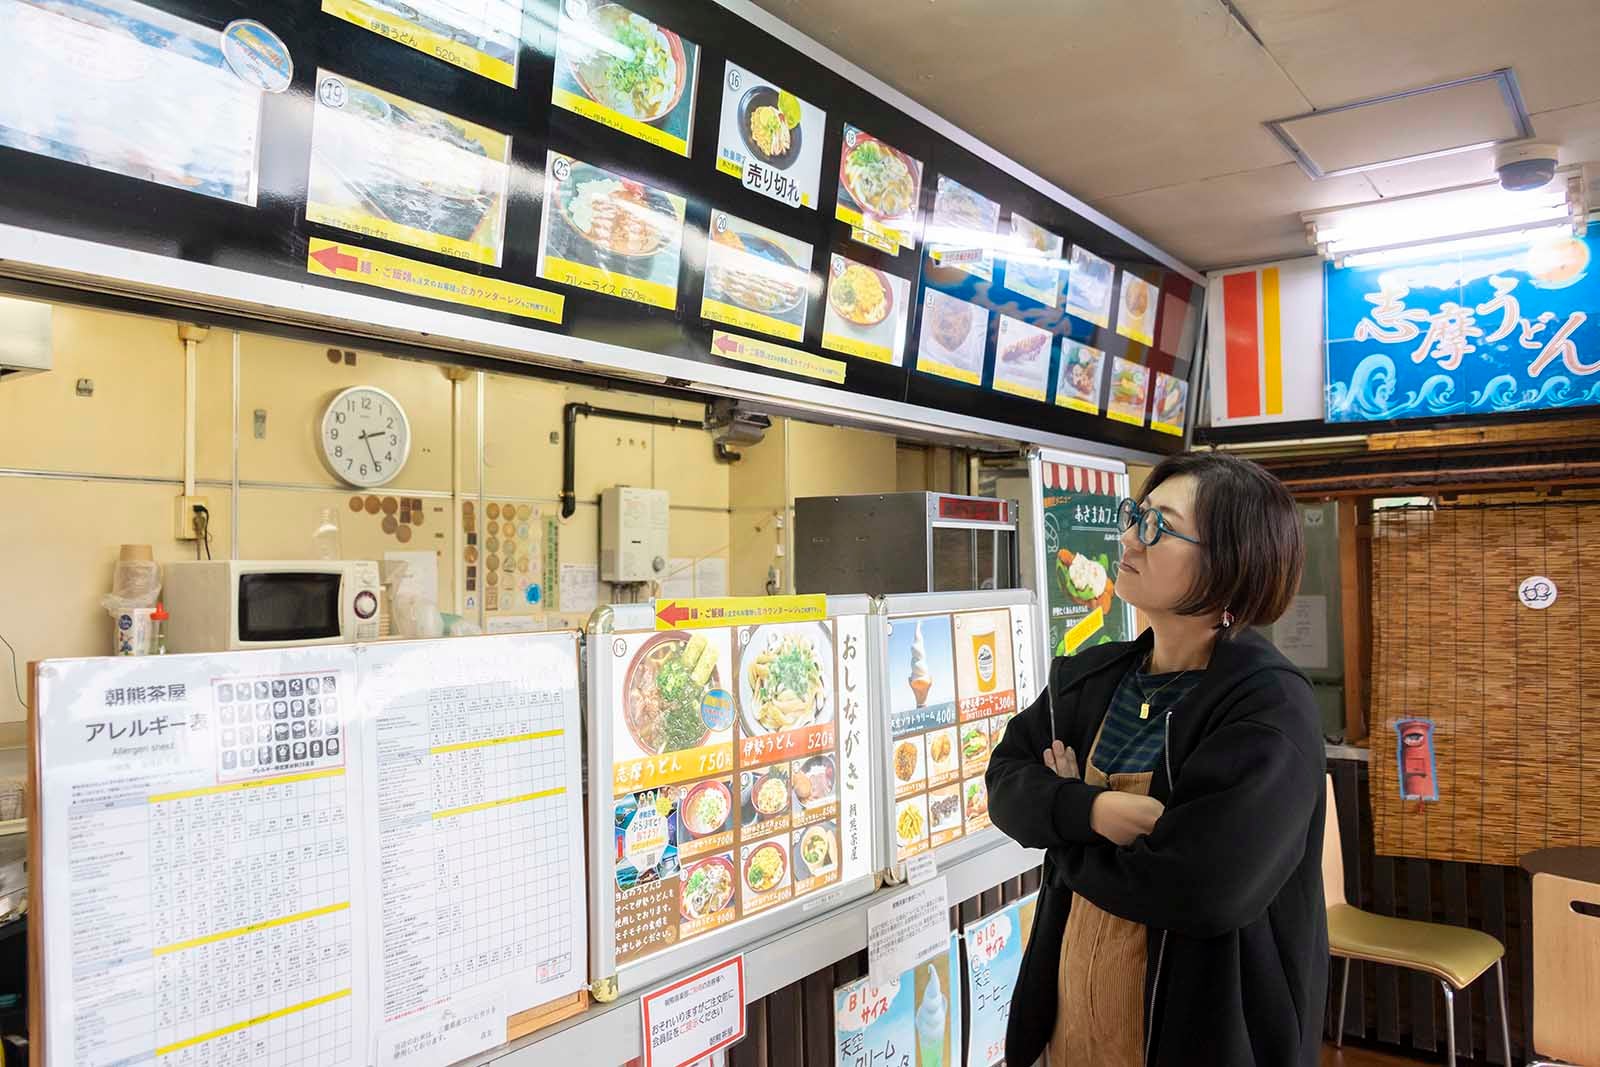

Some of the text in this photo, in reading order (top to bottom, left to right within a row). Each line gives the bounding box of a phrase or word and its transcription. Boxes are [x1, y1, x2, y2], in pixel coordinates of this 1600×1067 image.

[370, 19, 418, 48] 伊勢うどん
[555, 161, 569, 177] 25
[747, 163, 800, 202] 売り切れ
[565, 274, 616, 295] カレーライス
[1354, 273, 1600, 378] 志摩うどん
[347, 400, 355, 412] 11
[361, 398, 371, 409] 12
[336, 412, 345, 424] 10
[387, 417, 393, 429] 2
[331, 428, 338, 440] 9
[390, 434, 397, 446] 3
[335, 446, 342, 457] 8
[385, 451, 392, 461] 4
[345, 459, 353, 470] 7
[360, 464, 367, 476] 6
[375, 461, 382, 472] 5
[105, 683, 187, 706] 朝熊茶屋
[842, 634, 860, 790] おしながき
[85, 713, 208, 742] アレルギー表
[743, 733, 795, 757] 伊勢うどん
[616, 755, 682, 783] 志摩うどん
[976, 922, 996, 946] BIG
[977, 984, 1008, 1012] コーヒー
[861, 996, 888, 1024] サイズ
[840, 1032, 864, 1061] 天空
